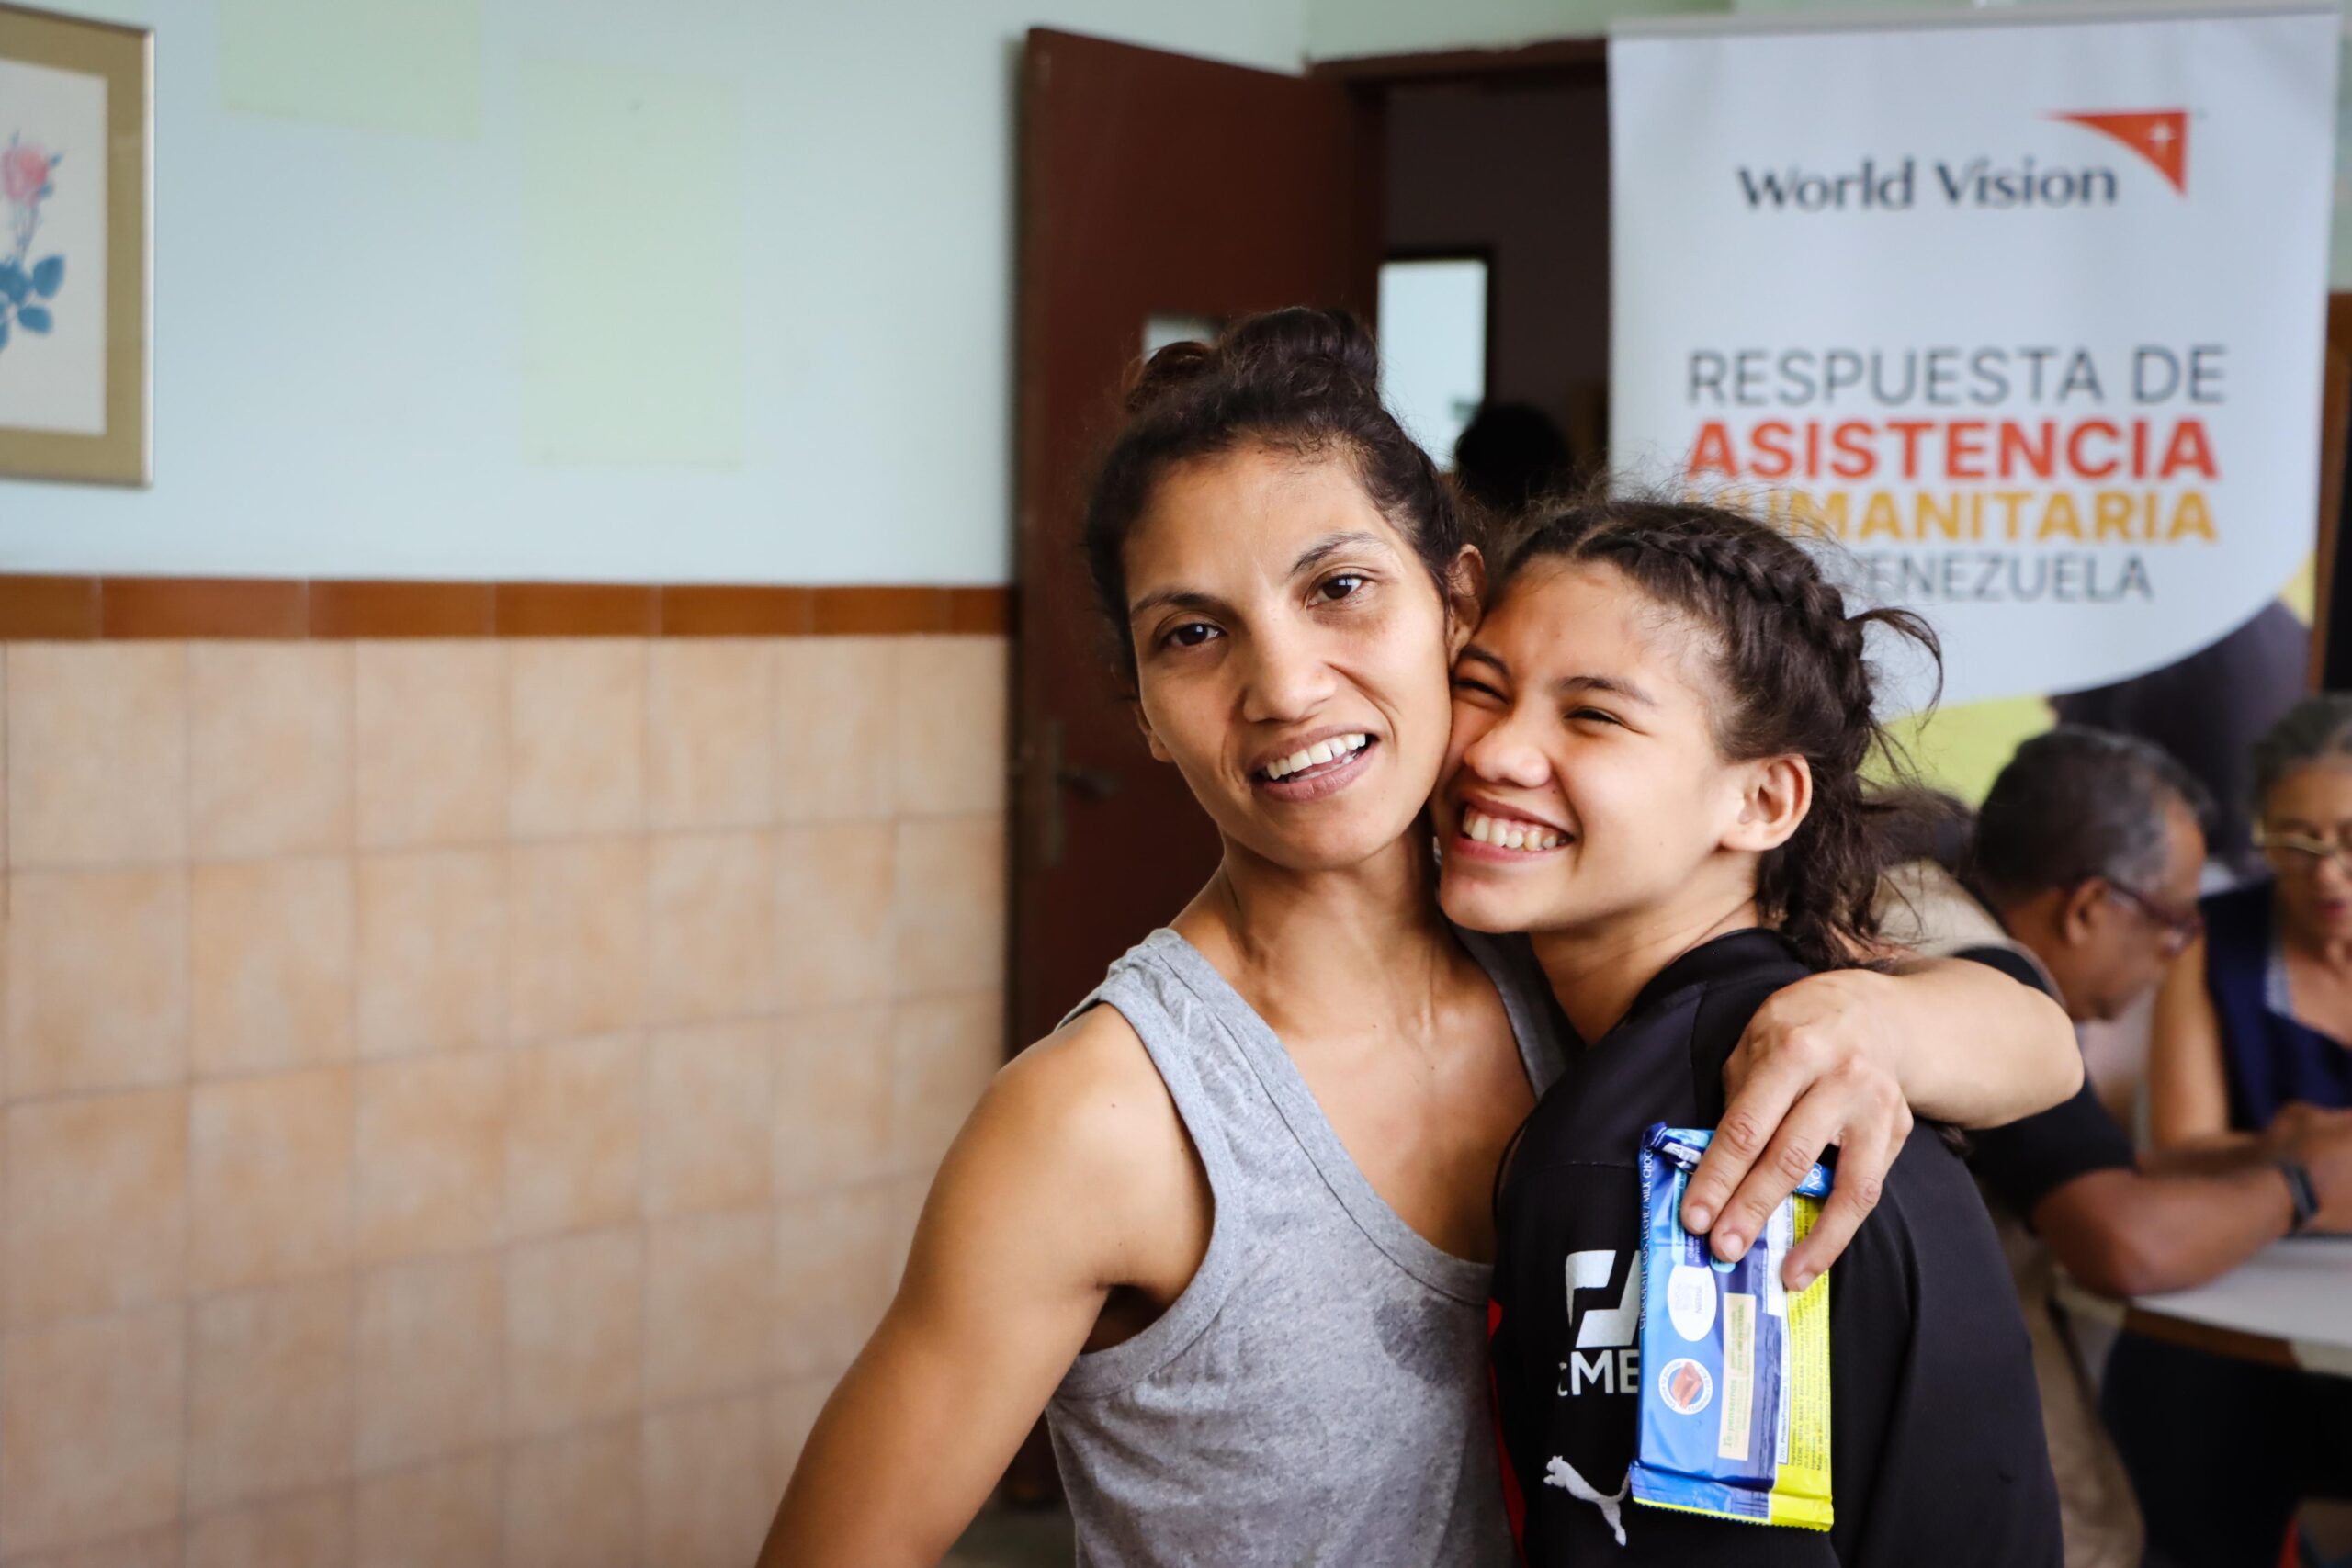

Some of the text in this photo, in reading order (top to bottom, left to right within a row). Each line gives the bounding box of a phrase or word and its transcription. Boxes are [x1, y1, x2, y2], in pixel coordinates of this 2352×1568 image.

[1736, 156, 2120, 211] World Vision
[1687, 344, 2227, 407] RESPUESTA DE
[1685, 417, 2222, 481] ASISTENCIA
[1849, 550, 2154, 604] ENEZUELA
[1642, 1181, 1651, 1203] MILK
